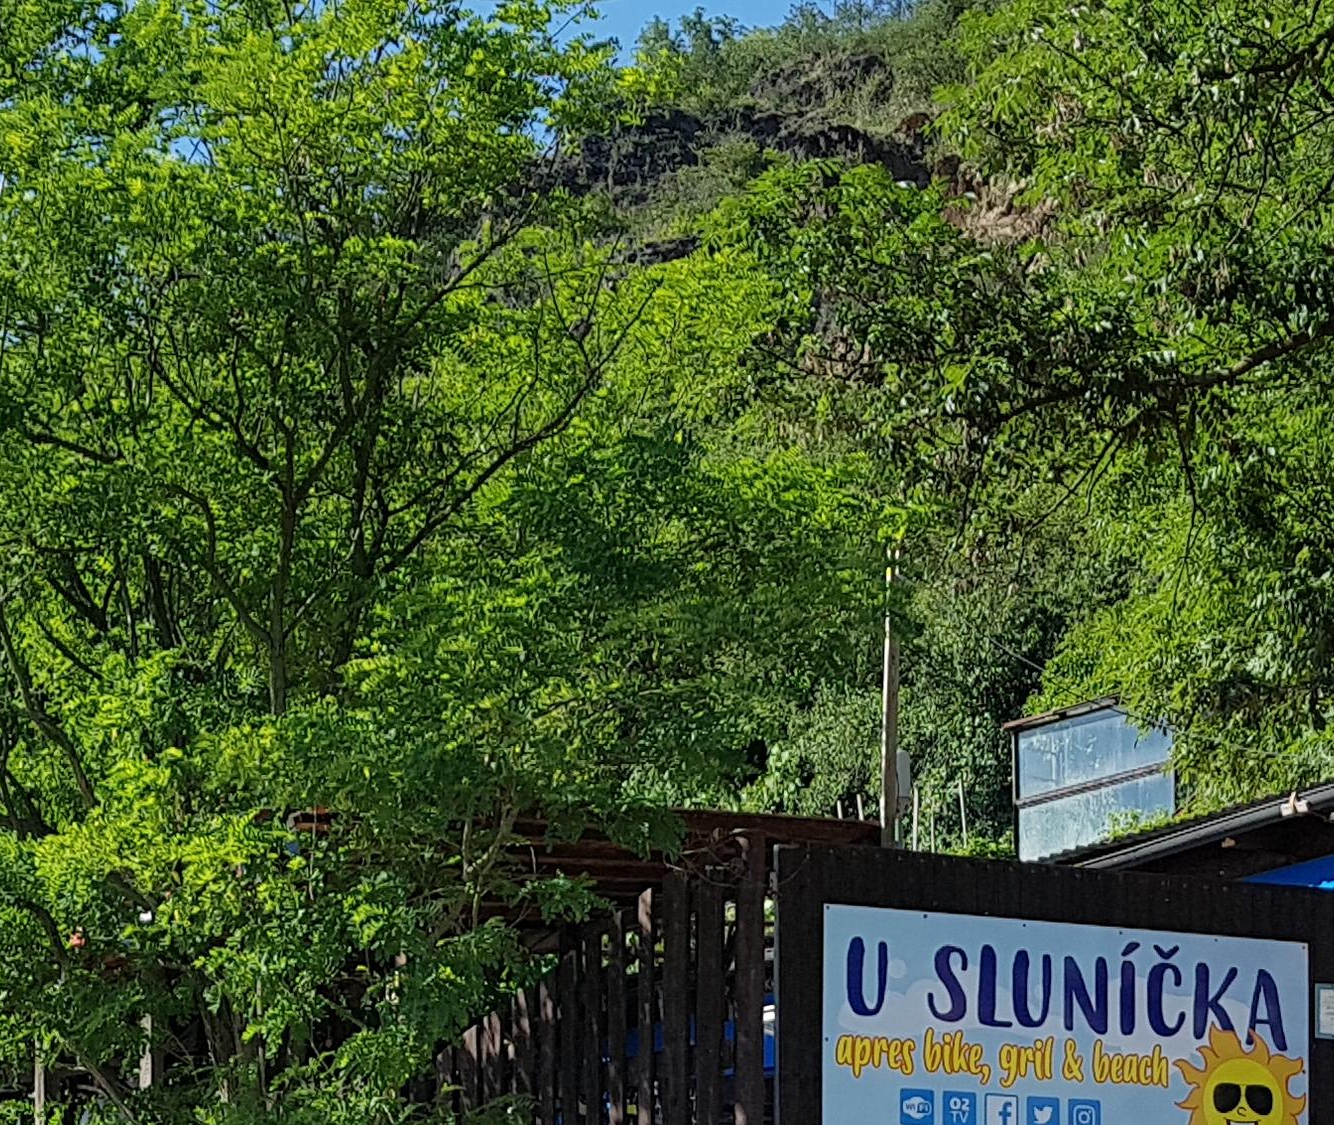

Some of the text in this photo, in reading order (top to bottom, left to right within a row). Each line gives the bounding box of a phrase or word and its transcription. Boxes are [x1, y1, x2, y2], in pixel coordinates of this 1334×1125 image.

[847, 936, 1288, 1052] U SLUNÍČKA
[834, 1027, 1169, 1089] apres bike, gril & beach
